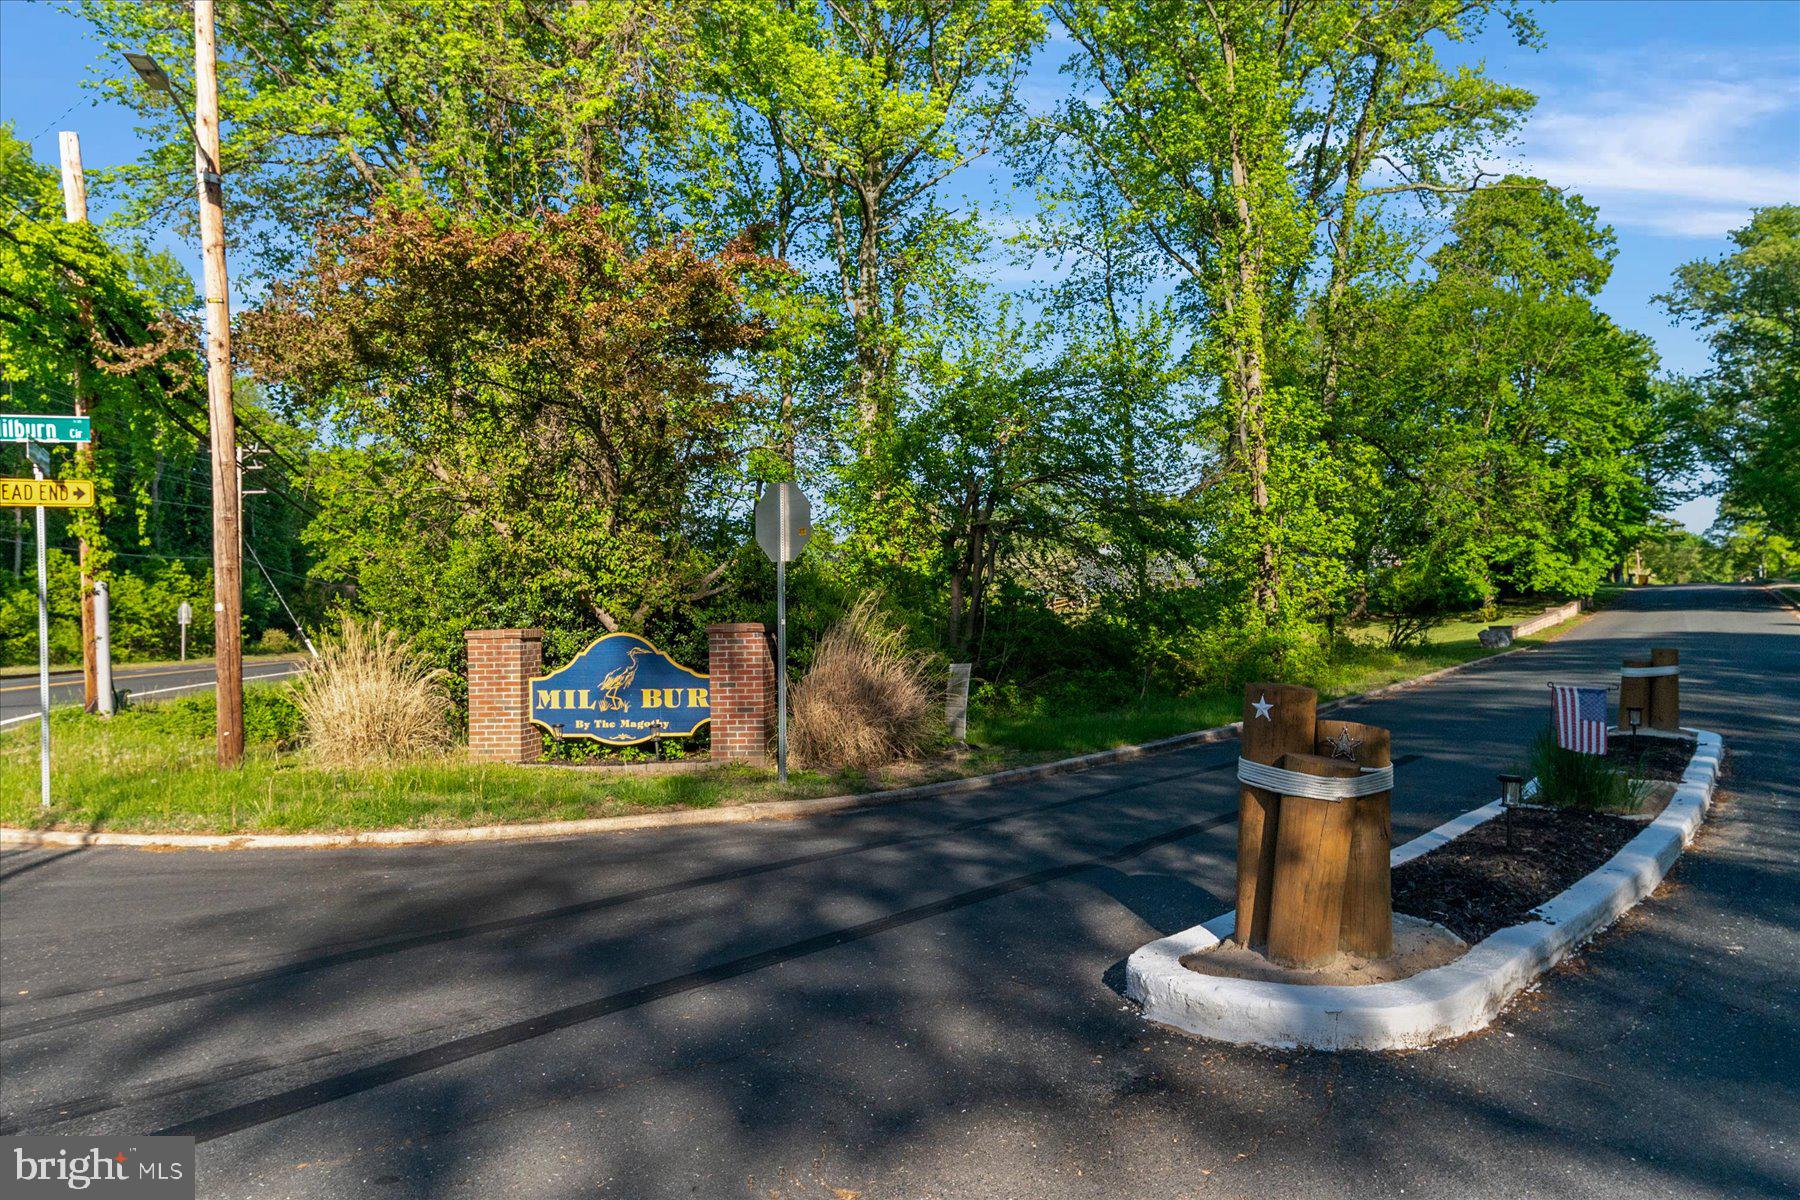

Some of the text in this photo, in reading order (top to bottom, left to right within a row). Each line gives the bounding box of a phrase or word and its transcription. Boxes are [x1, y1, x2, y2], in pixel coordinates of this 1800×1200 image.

[0, 419, 83, 439] ilburn Cir
[0, 484, 69, 501] EAD END
[536, 688, 711, 711] MIL BUR
[575, 720, 590, 730] By
[594, 719, 616, 729] The
